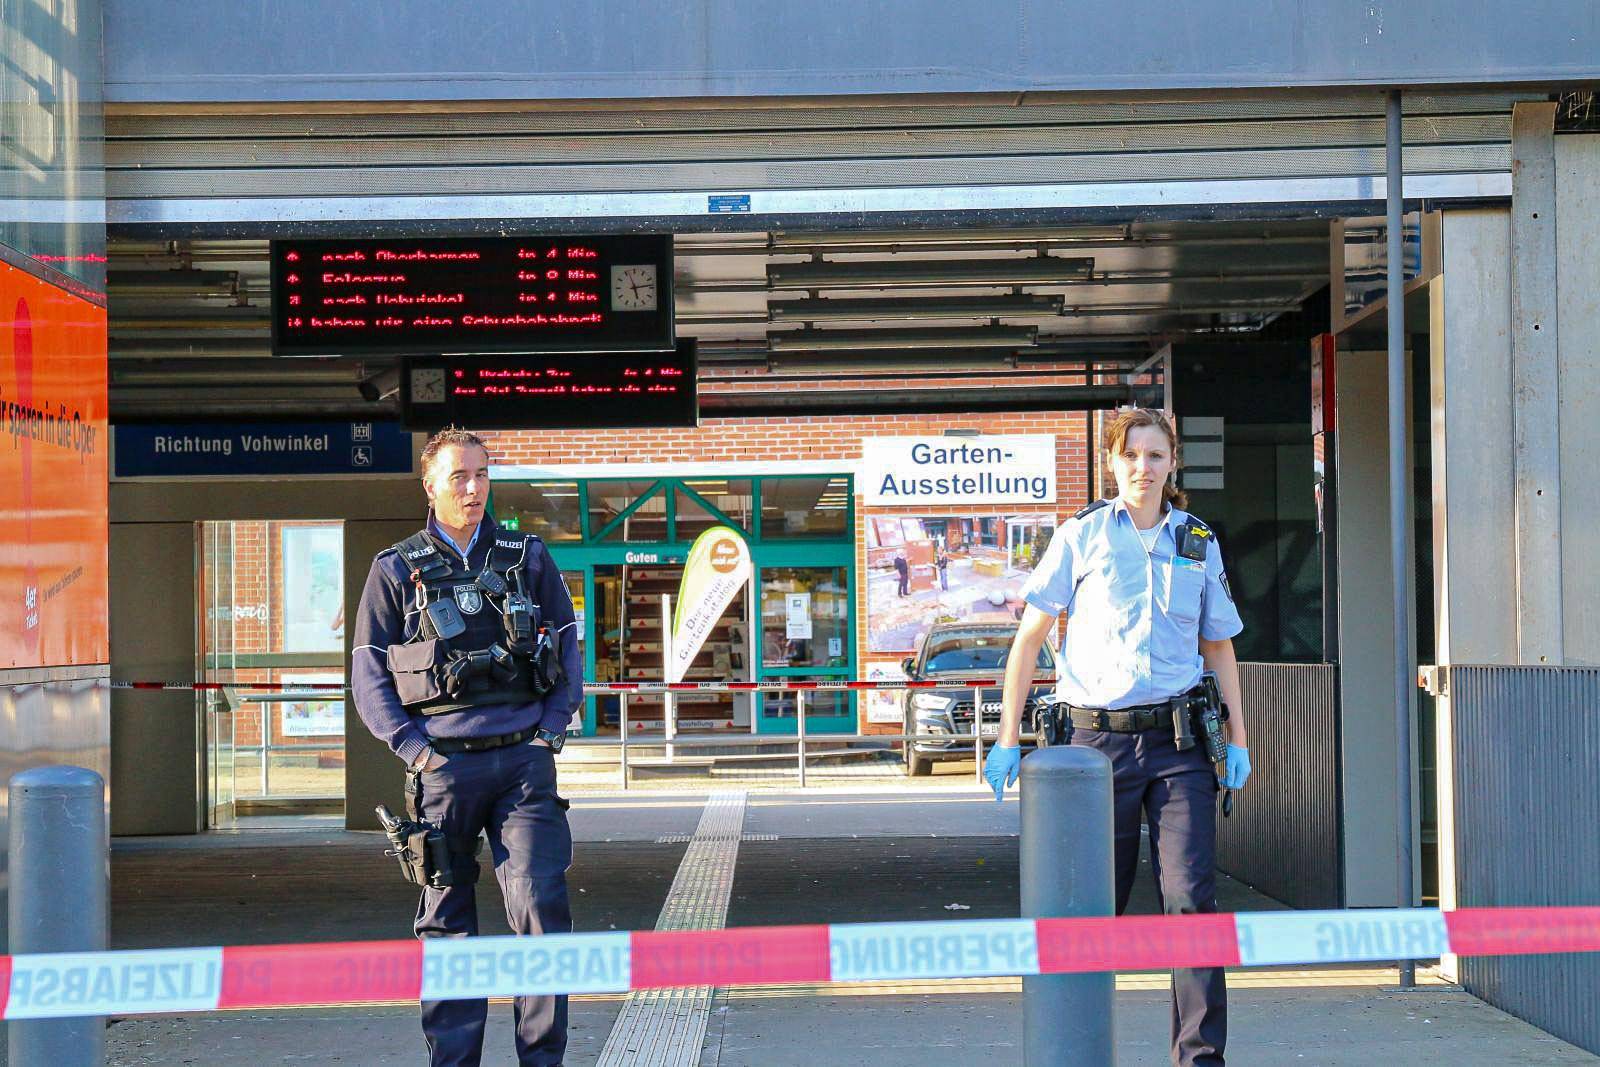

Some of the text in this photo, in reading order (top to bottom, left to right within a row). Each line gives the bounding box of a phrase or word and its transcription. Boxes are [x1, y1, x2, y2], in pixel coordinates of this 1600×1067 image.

[9, 401, 43, 450] sparen
[45, 400, 54, 446] in
[57, 403, 71, 449] die
[73, 410, 96, 465] Oper
[155, 434, 328, 455] Richtung Vohwinkel
[911, 444, 1012, 464] Garten-
[879, 473, 1047, 498] Ausstellung
[408, 545, 434, 559] POLIZEI
[495, 538, 523, 549] POLIZEI
[625, 552, 657, 563] Guten
